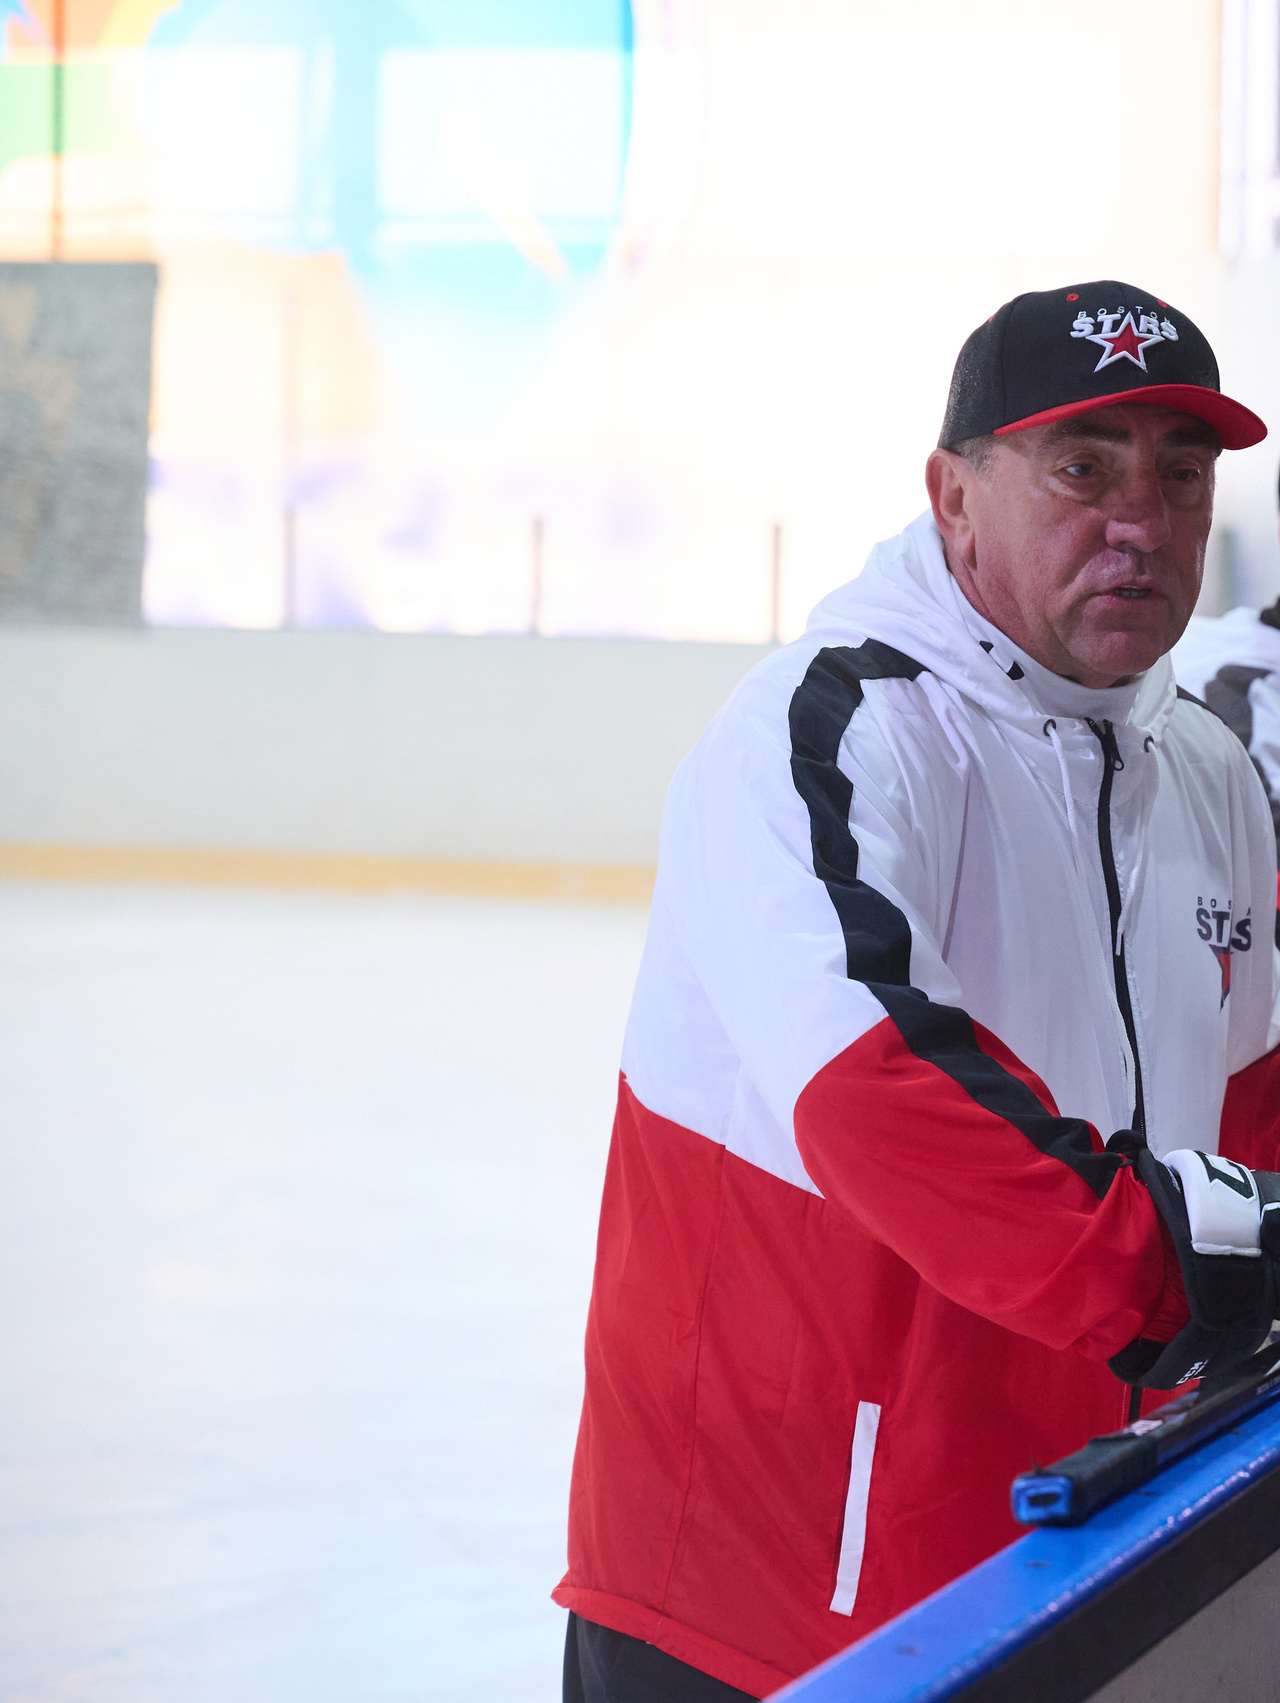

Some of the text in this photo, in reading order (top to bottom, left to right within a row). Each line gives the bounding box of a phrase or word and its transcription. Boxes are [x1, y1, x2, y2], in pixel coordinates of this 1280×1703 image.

[1069, 311, 1179, 344] STARS
[1077, 305, 1171, 324] BOSTON
[1196, 907, 1252, 952] STS
[1176, 1361, 1203, 1385] CCM
